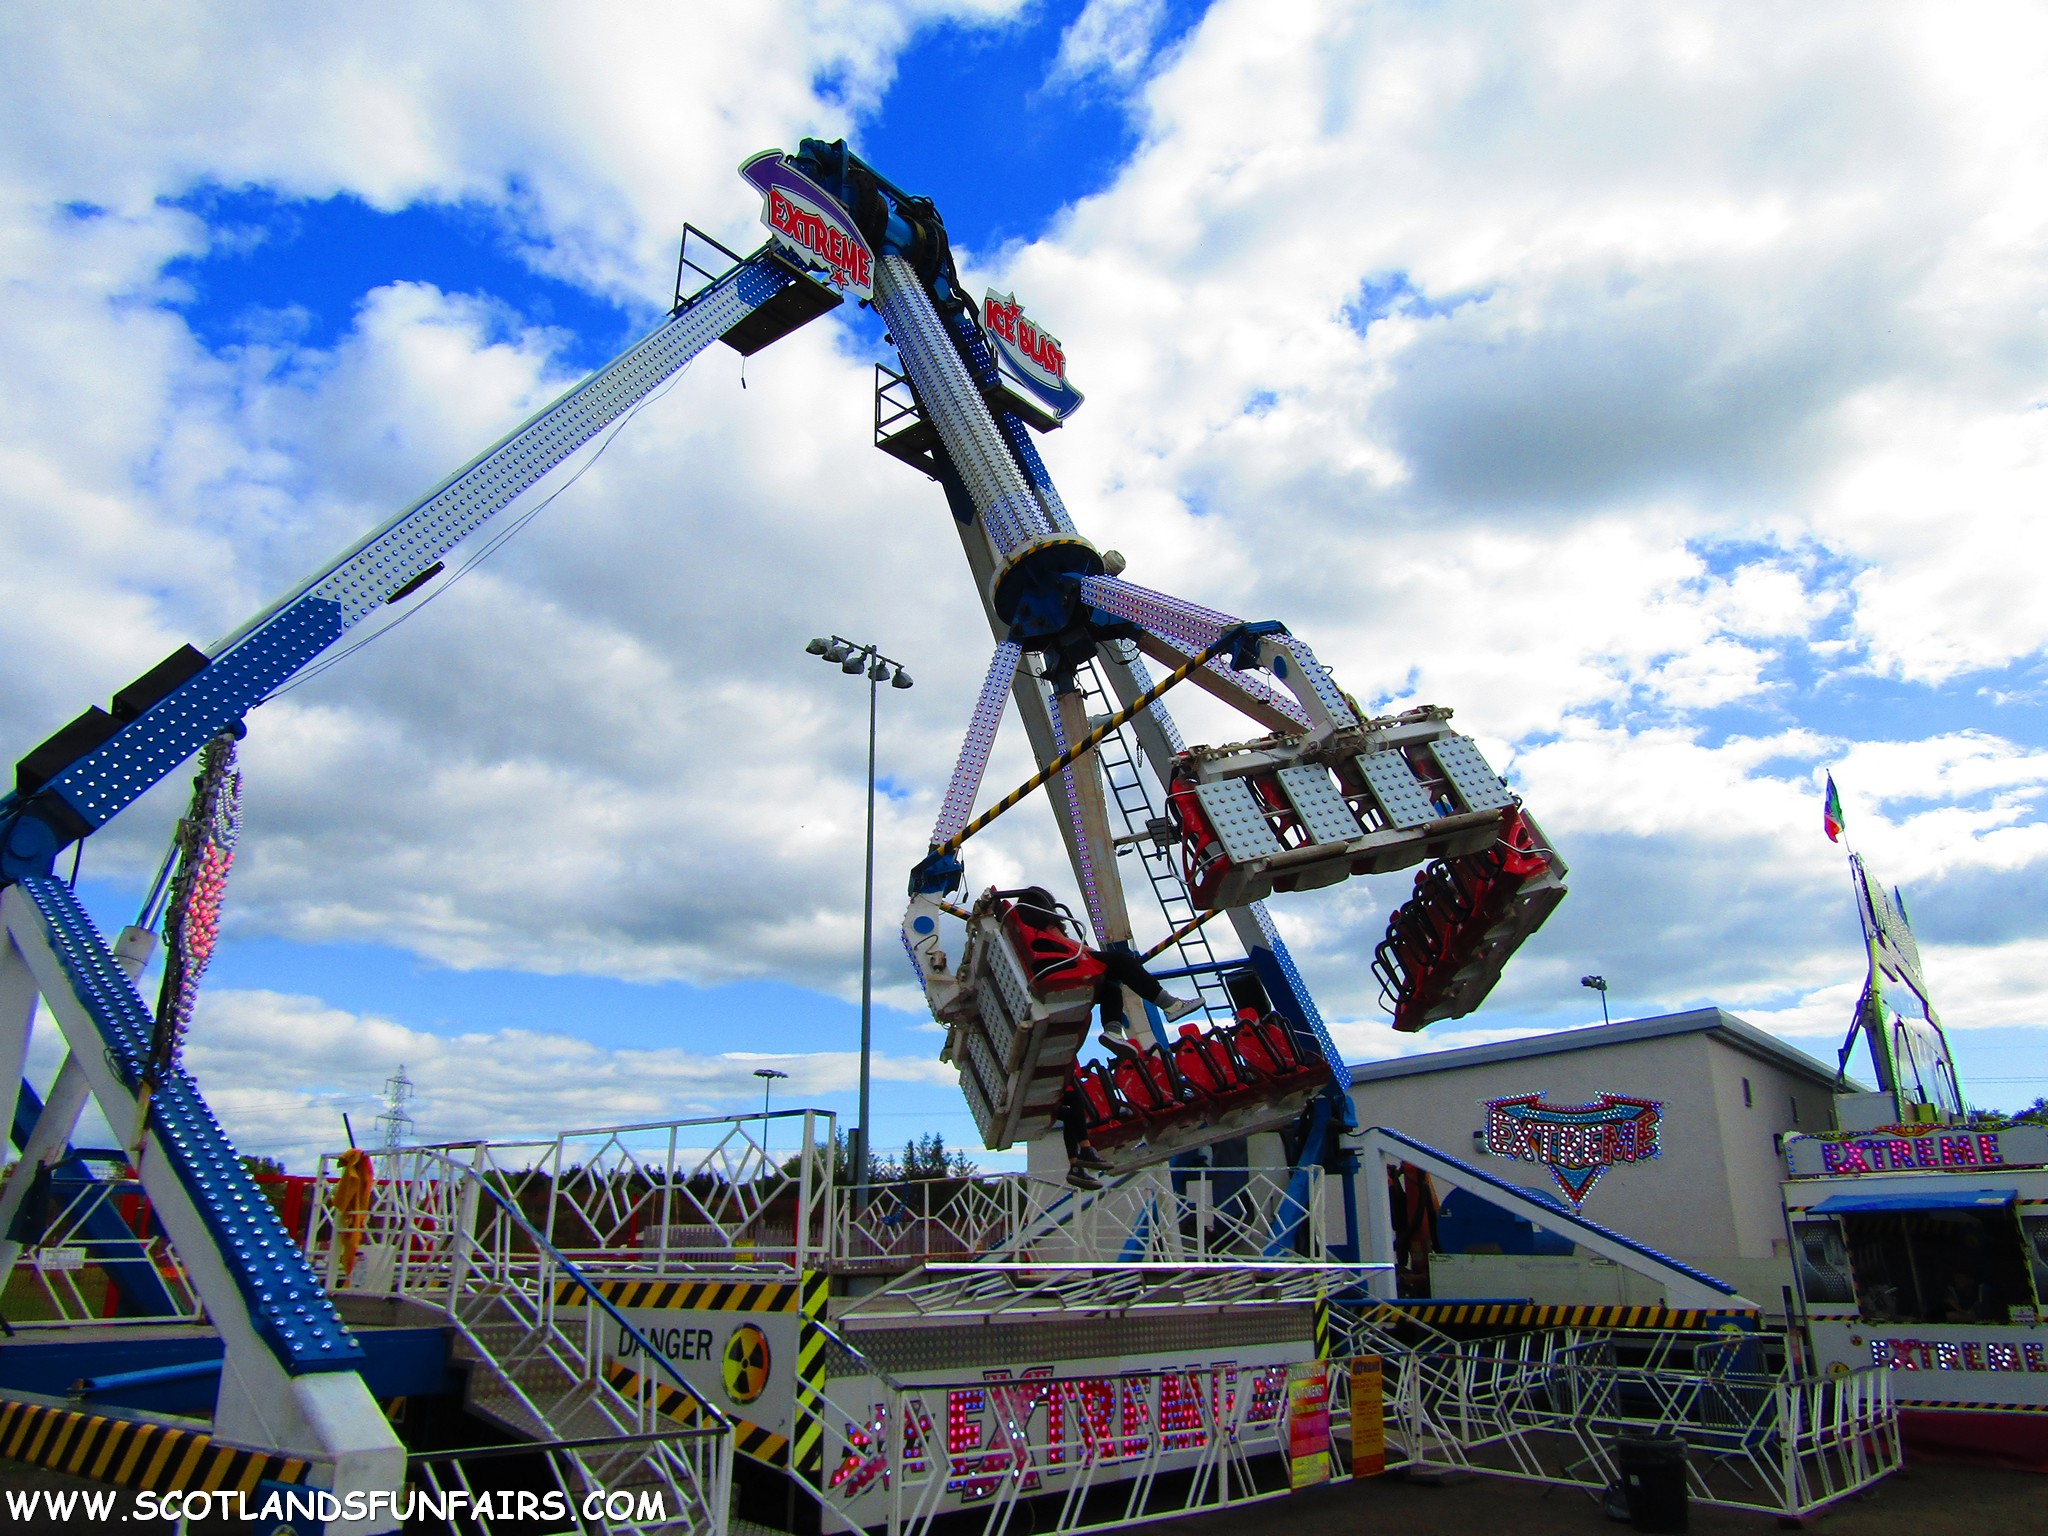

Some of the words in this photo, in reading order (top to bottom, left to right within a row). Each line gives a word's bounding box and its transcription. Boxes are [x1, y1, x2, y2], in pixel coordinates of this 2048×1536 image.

[768, 188, 872, 289] EXTREME
[985, 299, 1015, 343] ICE
[1018, 327, 1066, 380] BLAST
[1489, 1109, 1659, 1167] EXTREME
[1820, 1133, 2005, 1174] EXTREME
[1869, 1337, 2048, 1373] EXTREME
